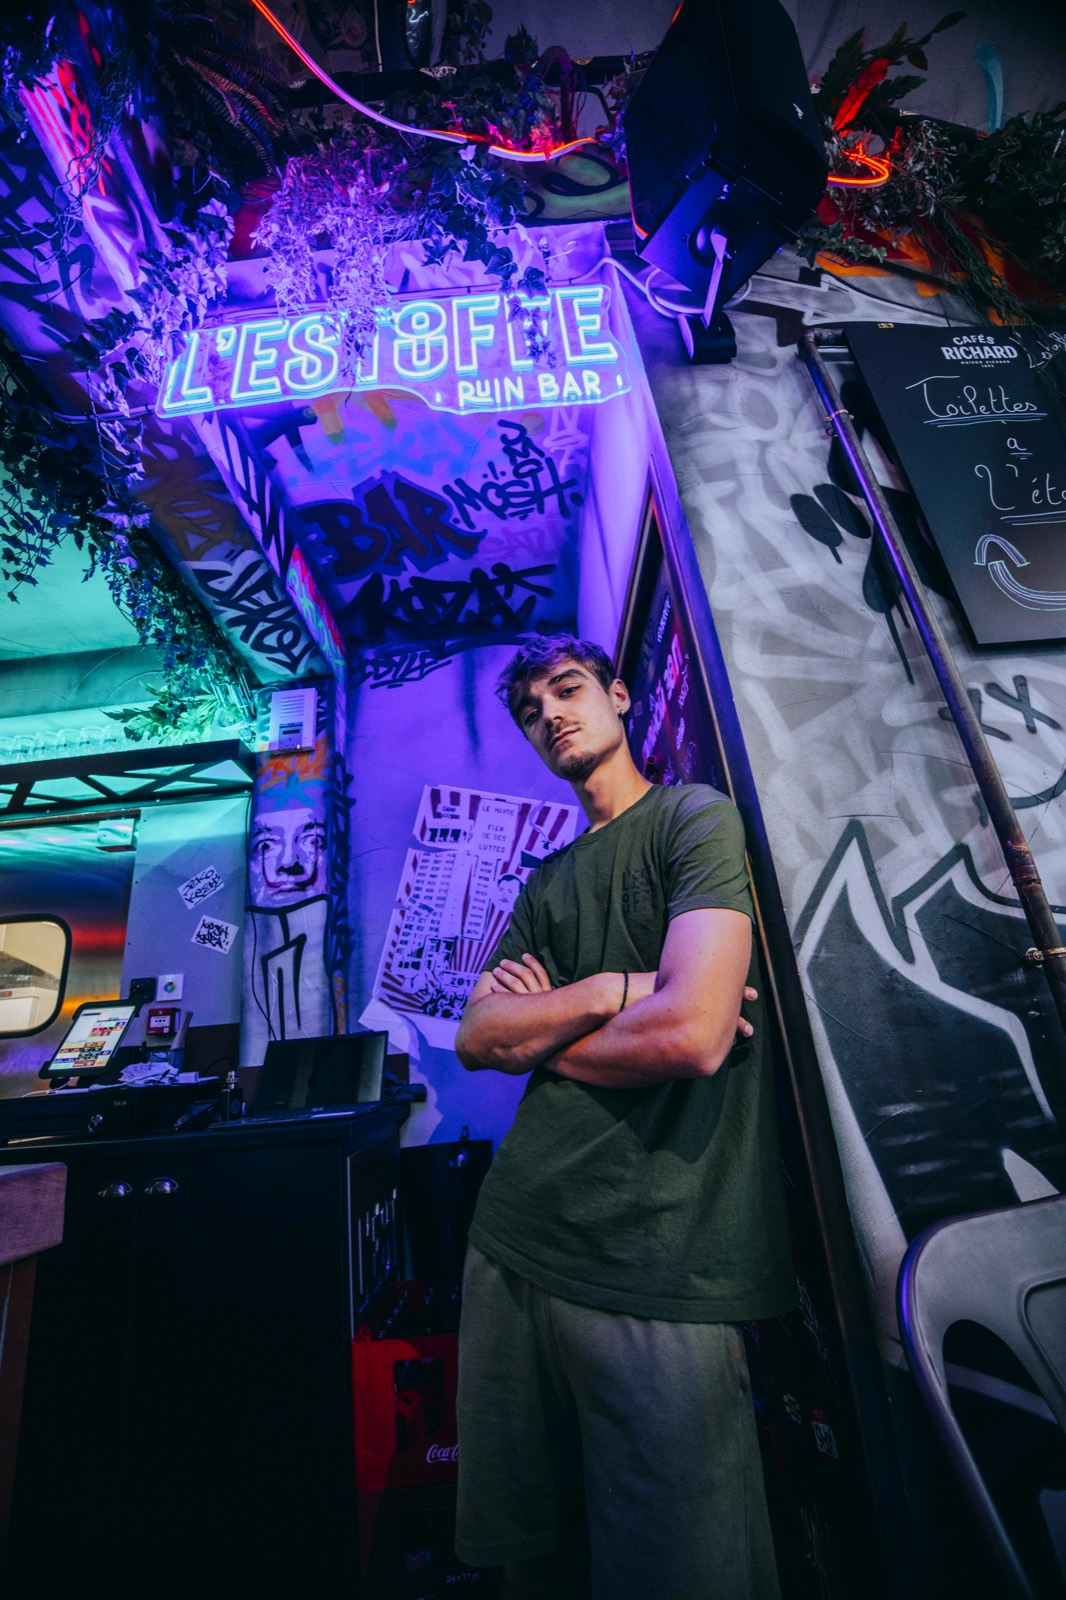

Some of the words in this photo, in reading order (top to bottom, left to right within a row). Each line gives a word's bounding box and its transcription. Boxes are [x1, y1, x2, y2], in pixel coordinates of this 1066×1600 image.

[952, 334, 995, 346] CAFÉS
[940, 345, 1019, 360] RICHARD
[457, 375, 525, 407] RUIN
[538, 369, 603, 400] BAR
[296, 469, 487, 583] BAR
[481, 805, 491, 813] LE
[487, 824, 505, 832] FIER
[493, 833, 507, 842] SES
[478, 843, 506, 854] LUTTES
[449, 976, 479, 988] 2017
